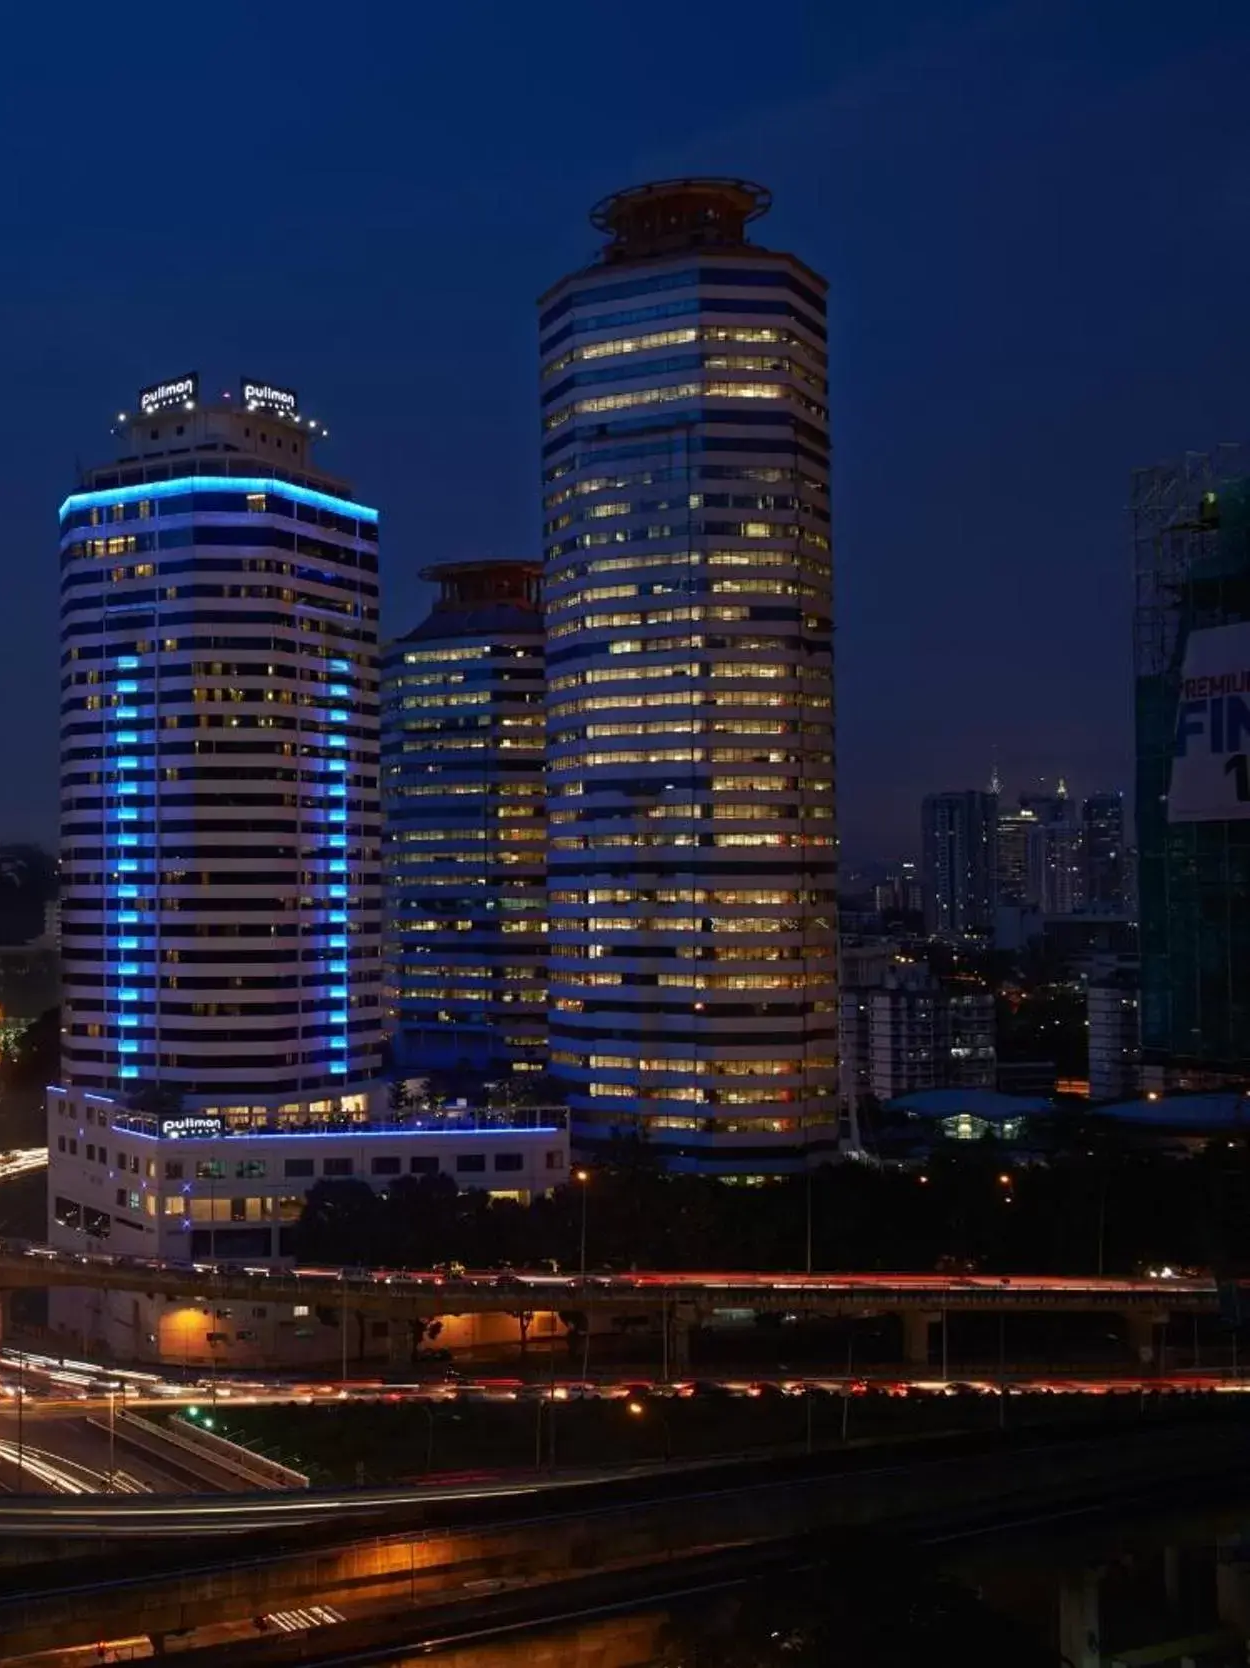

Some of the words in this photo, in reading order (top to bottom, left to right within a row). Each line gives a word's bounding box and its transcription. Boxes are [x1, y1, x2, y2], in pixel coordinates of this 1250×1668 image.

[141, 379, 193, 409] pullman
[244, 384, 295, 408] pullman
[162, 1116, 221, 1134] pullman
